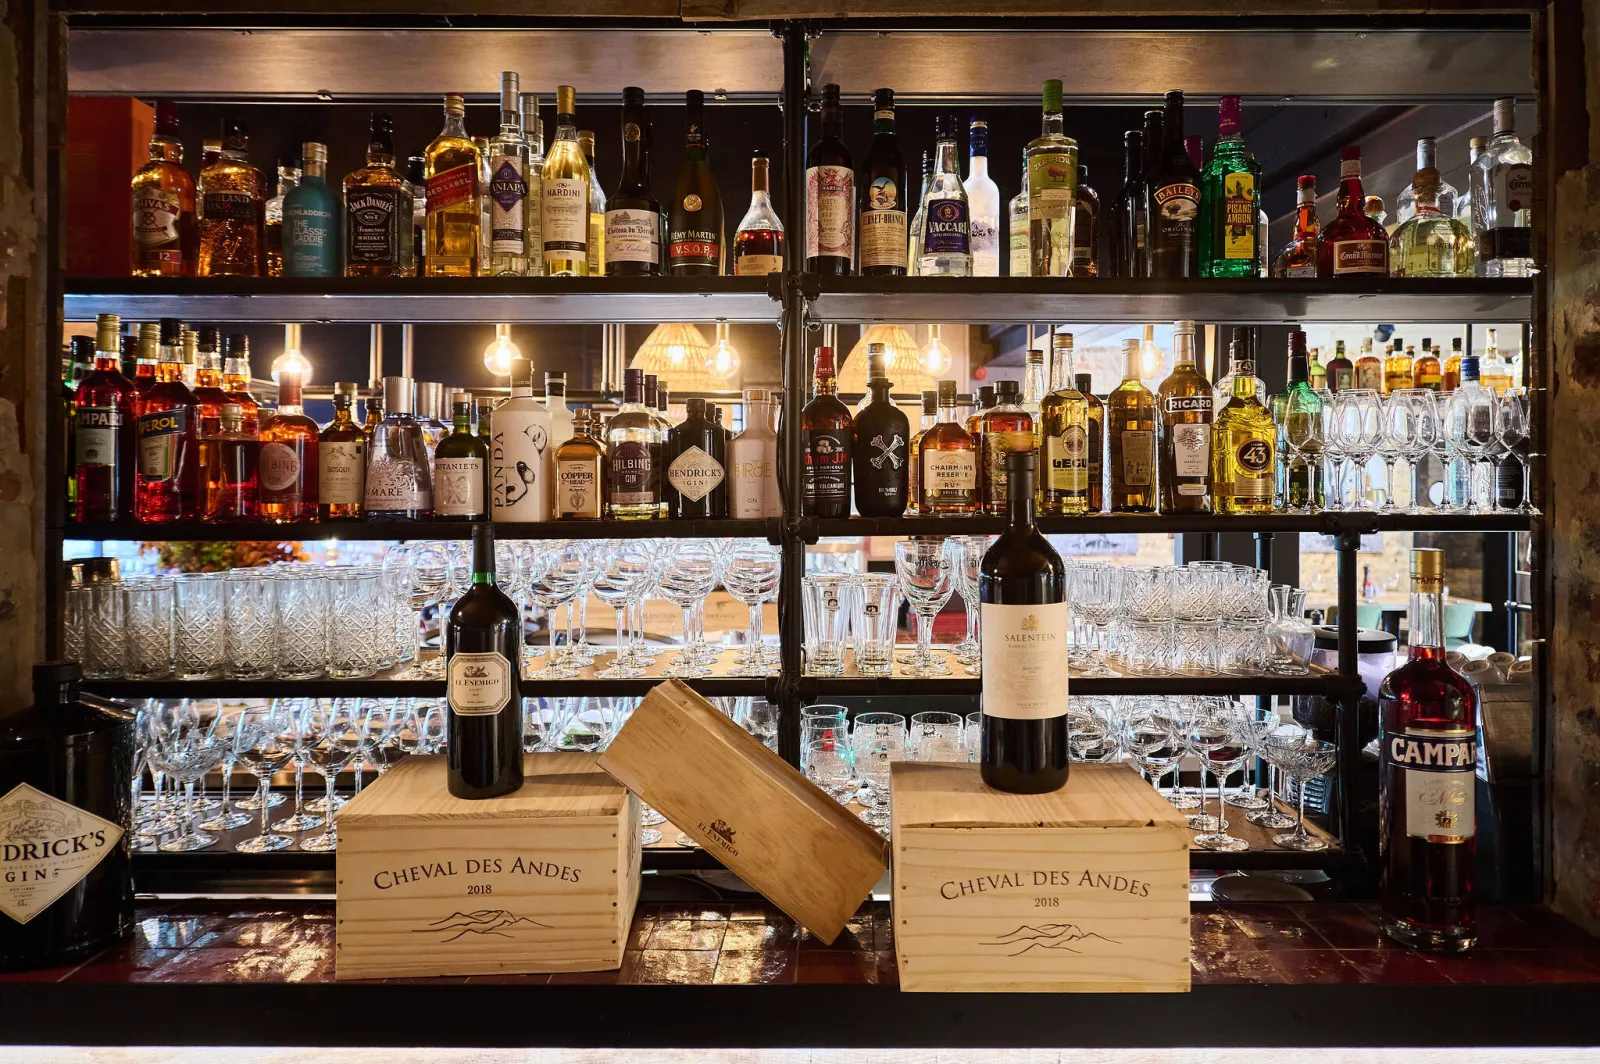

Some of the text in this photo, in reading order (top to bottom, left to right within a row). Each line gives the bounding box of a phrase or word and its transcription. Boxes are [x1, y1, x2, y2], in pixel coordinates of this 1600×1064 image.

[427, 186, 442, 197] RED
[444, 177, 473, 190] LABEL
[547, 188, 580, 197] NARDINI
[1158, 186, 1200, 200] BAILEYS
[138, 199, 171, 211] HIVAS
[350, 196, 394, 212] JACK DANIEL'S
[1227, 203, 1253, 214] PISANG
[293, 219, 308, 227] THE
[1226, 214, 1252, 223] AMBON
[293, 228, 328, 236] CLASSIC
[928, 221, 968, 235] VACCARI
[293, 235, 324, 243] LADDIE
[671, 229, 716, 240] RÉMY MARTIN
[158, 252, 171, 261] 12
[1340, 250, 1384, 260] Grand Marnier
[1171, 399, 1212, 410] RICARD
[77, 411, 124, 426] AMPARI
[140, 416, 179, 433] PEROL
[1243, 446, 1267, 464] 43
[262, 460, 297, 473] ILBING
[494, 431, 504, 508] PANDA
[613, 458, 651, 472] HILBING
[930, 464, 973, 472] CHAIRMAN'S
[561, 472, 594, 480] COPPER
[625, 474, 637, 483] GIN
[669, 468, 723, 478] HENDRICK'S
[1004, 633, 1057, 643] SALENTEIN
[464, 679, 500, 687] ENEMIGO
[697, 822, 739, 857] EL ENEMIGO
[0, 831, 106, 861] DRICK'S
[5, 869, 47, 883] GIN
[374, 856, 583, 889] CHEVAL DES ANDES
[467, 884, 492, 895] 2018
[940, 869, 1152, 900] CHEVAL DES ANDES
[1034, 897, 1060, 908] 2018
